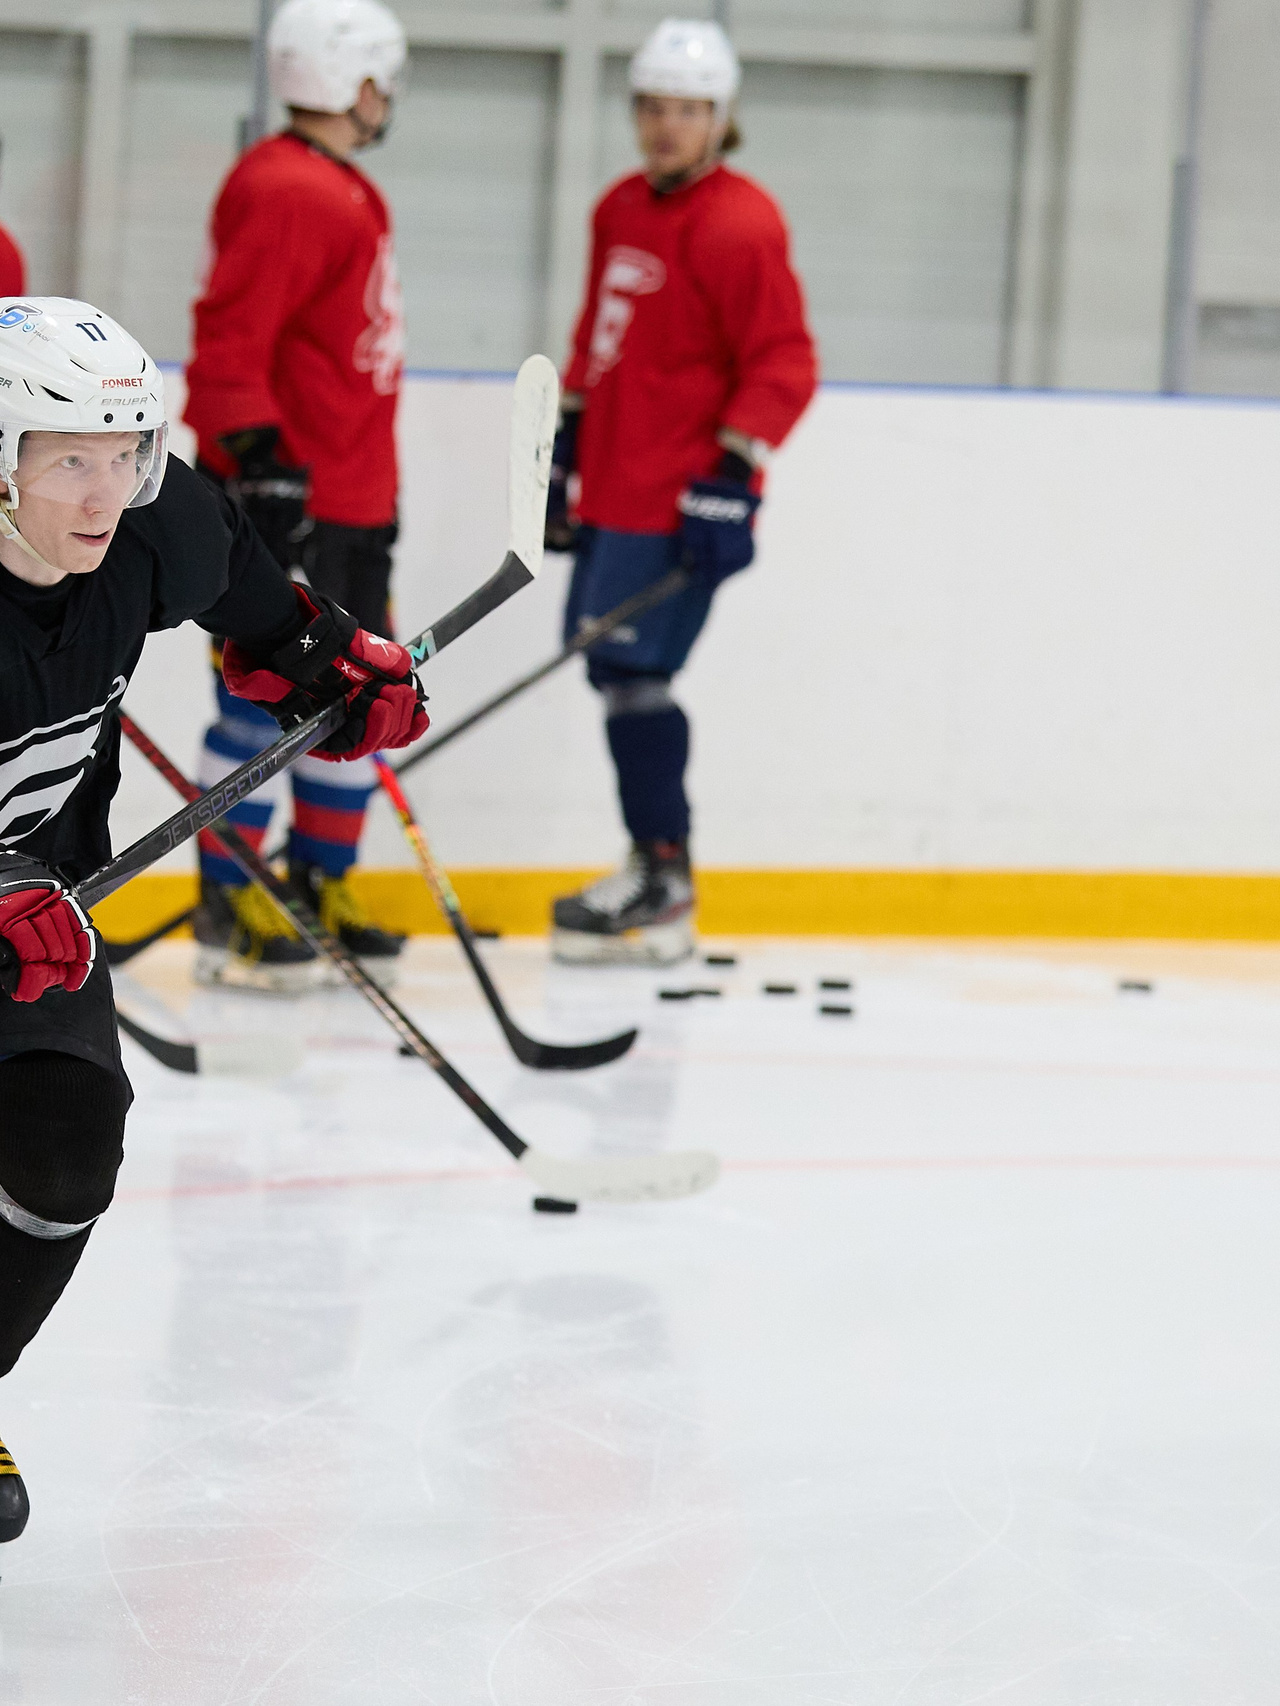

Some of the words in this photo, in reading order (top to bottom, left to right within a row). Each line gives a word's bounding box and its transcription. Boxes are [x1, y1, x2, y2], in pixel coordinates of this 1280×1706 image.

[75, 322, 107, 341] 17
[101, 377, 143, 388] FONBET
[160, 765, 263, 855] JETSPEED
